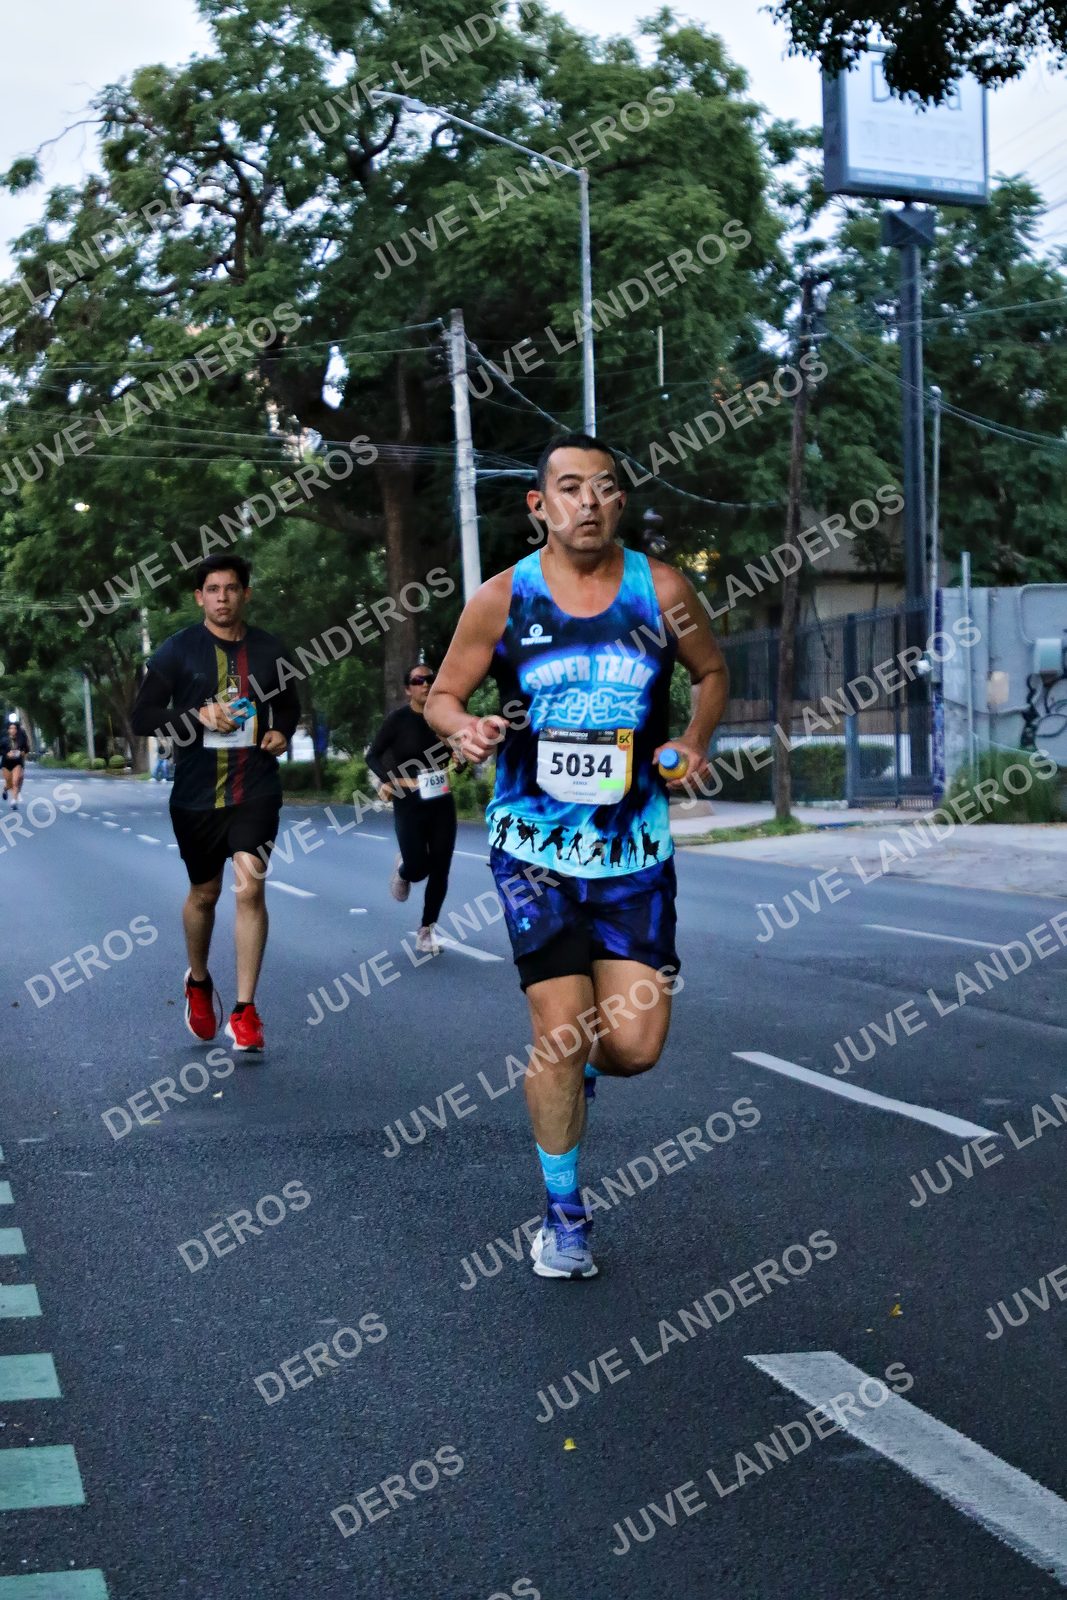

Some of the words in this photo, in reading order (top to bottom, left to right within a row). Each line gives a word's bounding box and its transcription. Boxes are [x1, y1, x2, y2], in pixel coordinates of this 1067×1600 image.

[525, 655, 591, 689] SUPER
[595, 654, 654, 689] TEAM
[550, 752, 613, 778] 5034
[424, 773, 445, 787] 7638
